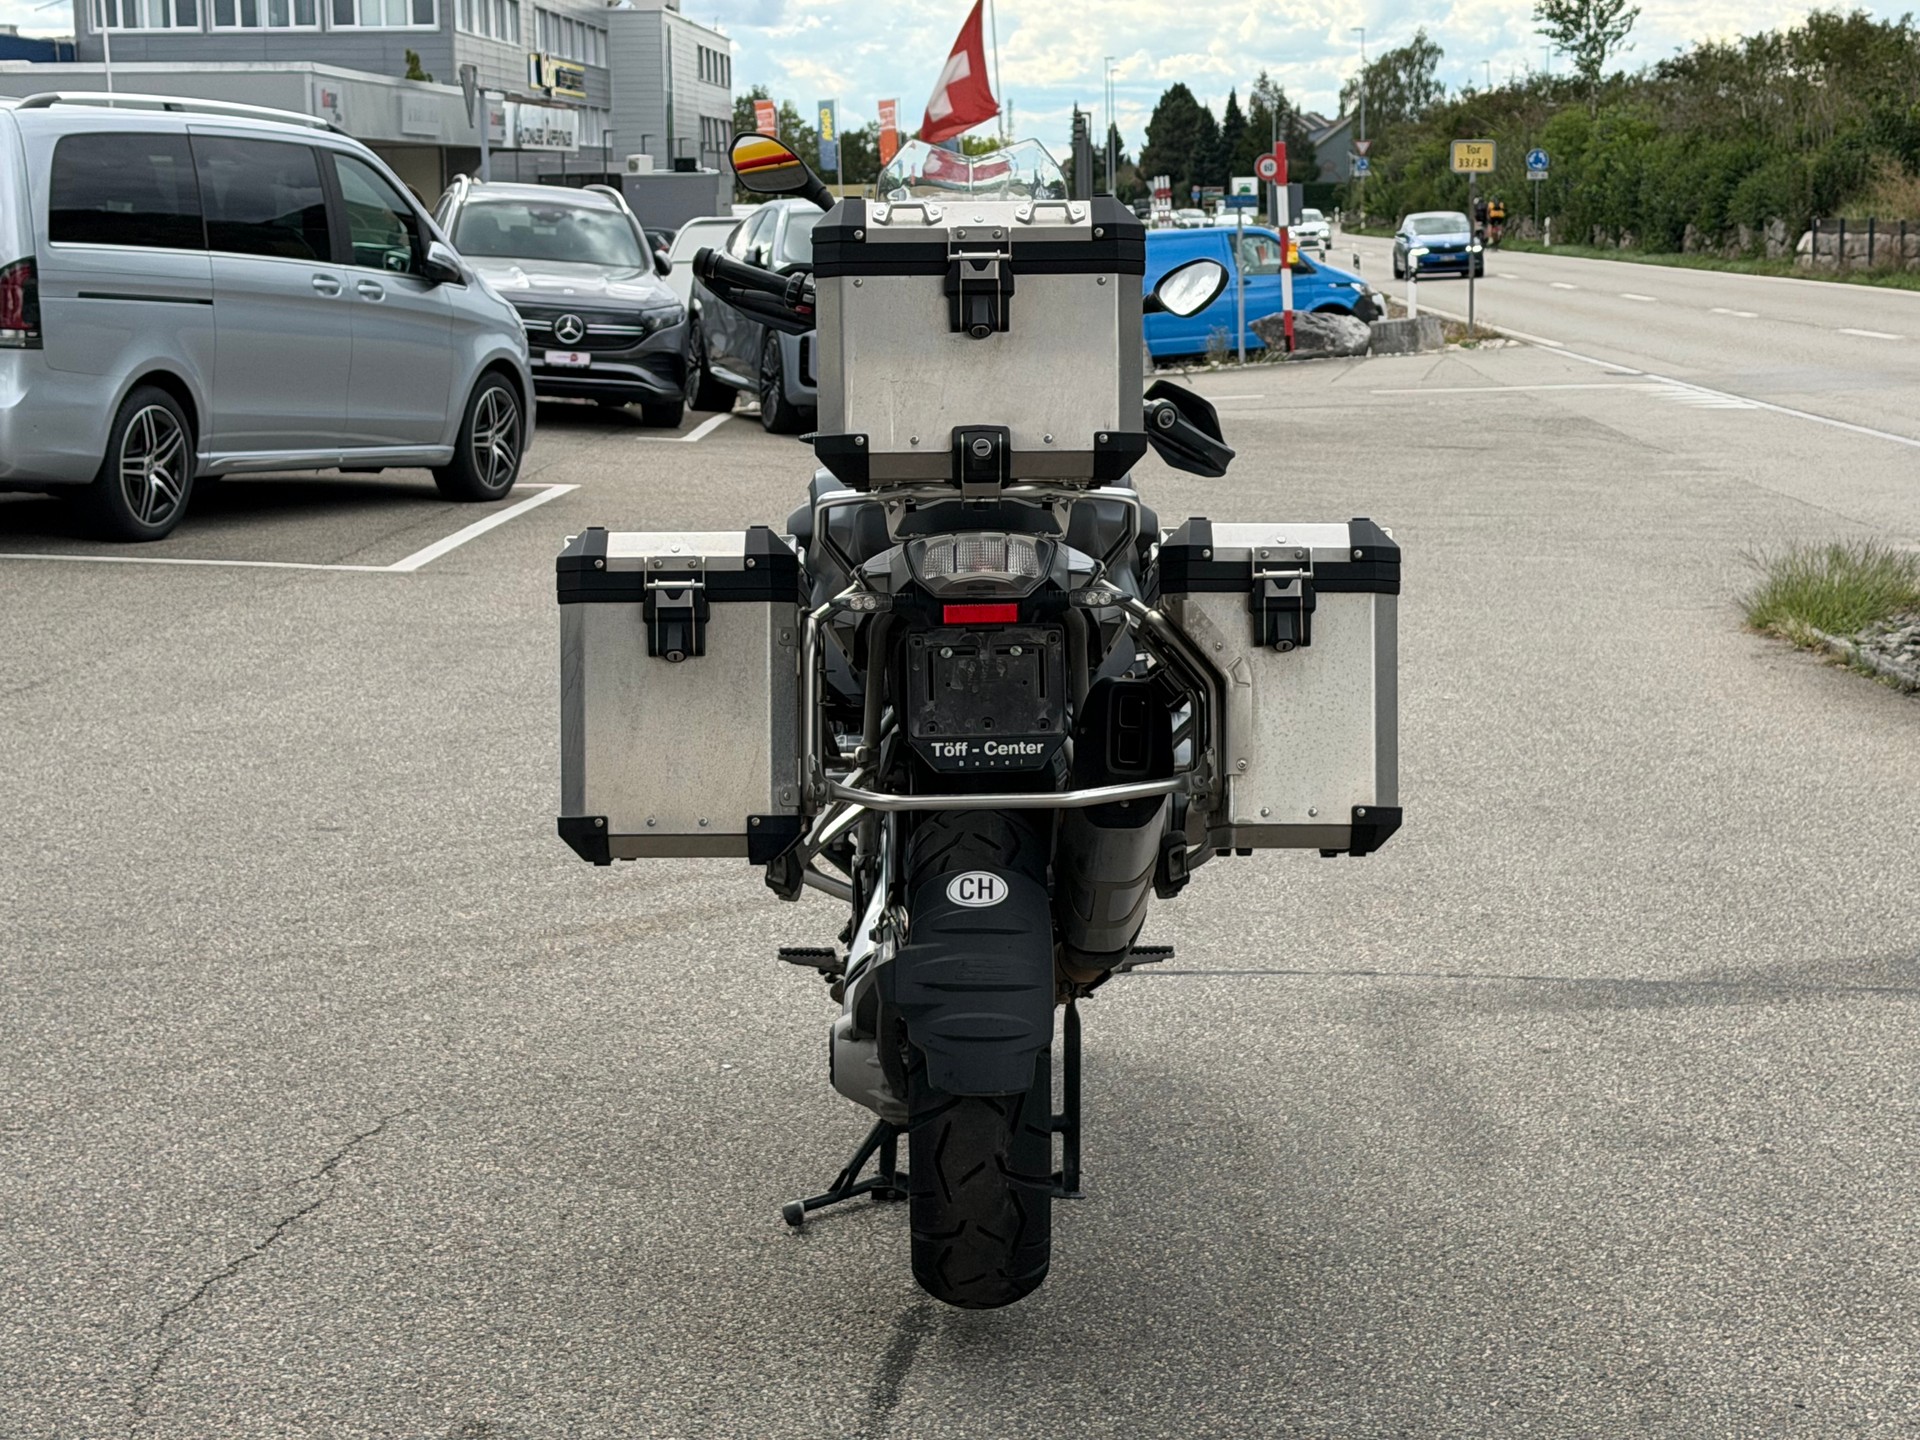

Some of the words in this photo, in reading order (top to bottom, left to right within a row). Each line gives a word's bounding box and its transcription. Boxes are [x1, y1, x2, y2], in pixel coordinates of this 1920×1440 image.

[1466, 145, 1481, 154] Tor
[1458, 158, 1489, 168] 33/34
[931, 742, 968, 757] Töff
[984, 741, 1044, 756] Center
[959, 877, 994, 900] CH
